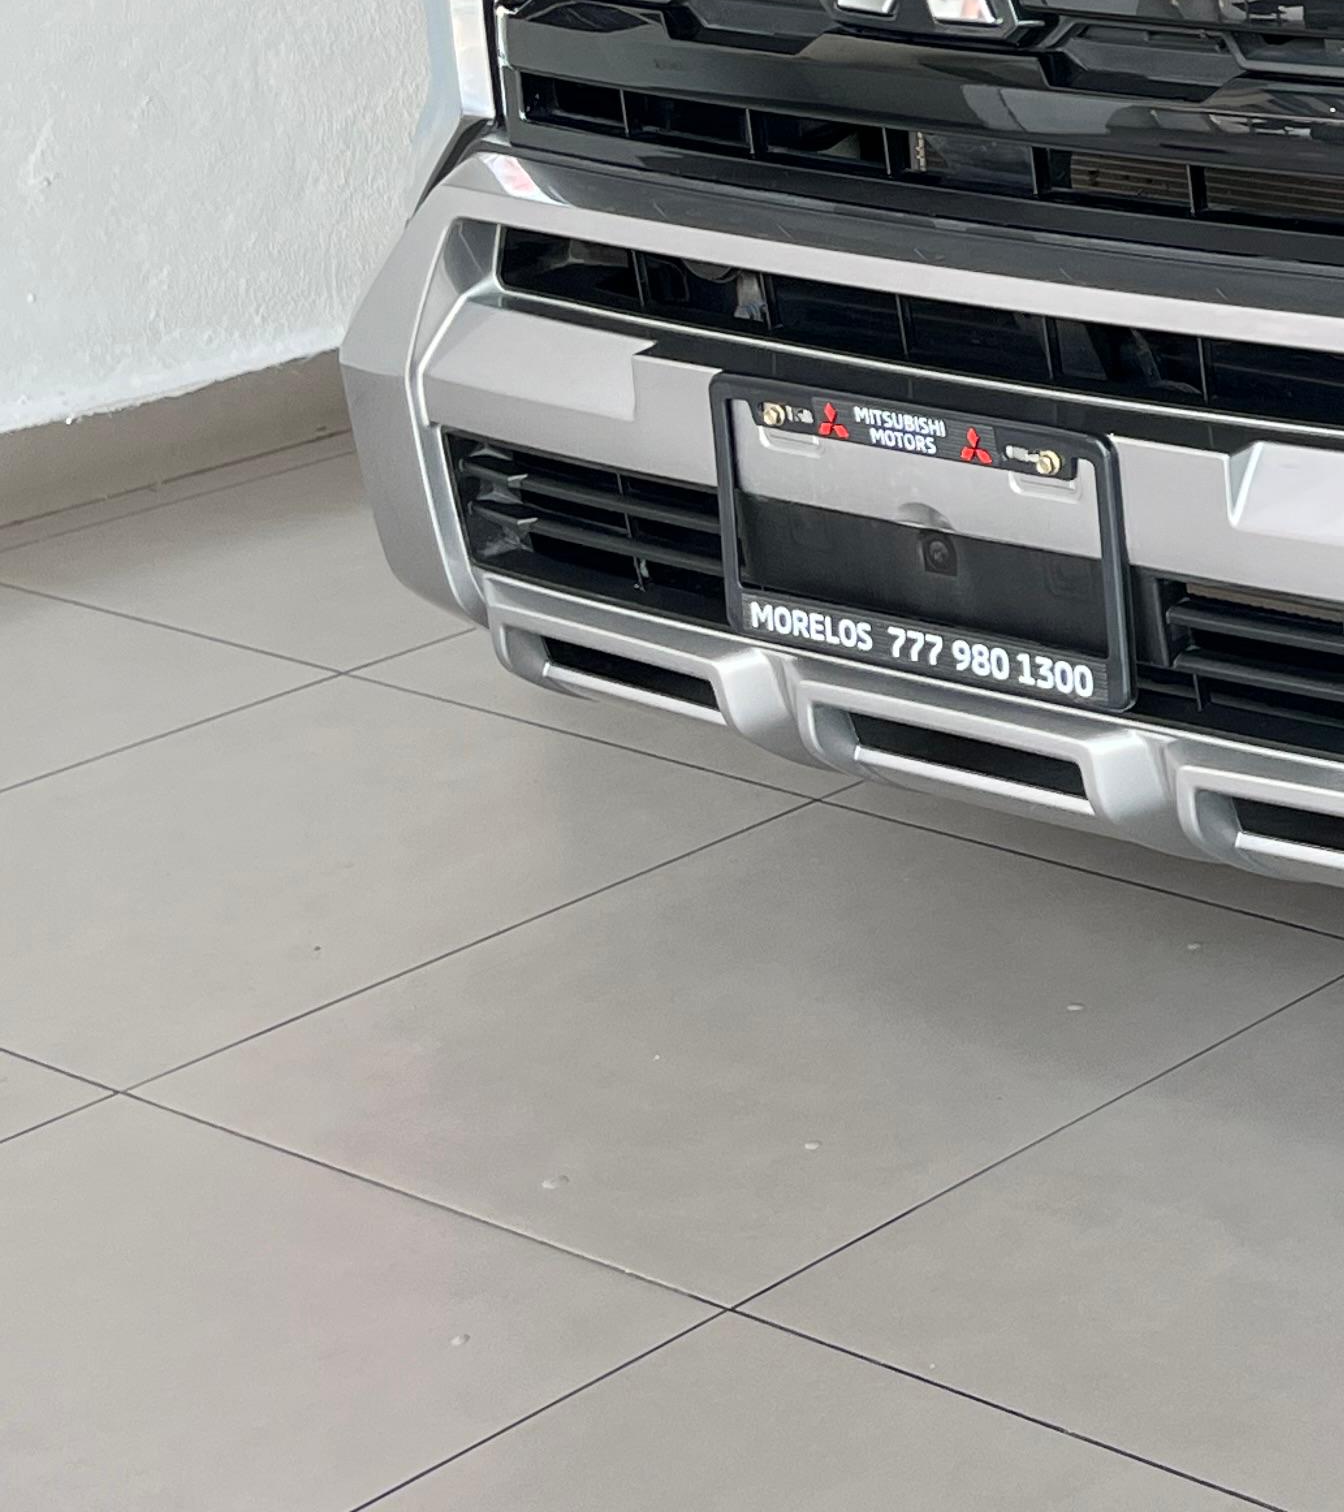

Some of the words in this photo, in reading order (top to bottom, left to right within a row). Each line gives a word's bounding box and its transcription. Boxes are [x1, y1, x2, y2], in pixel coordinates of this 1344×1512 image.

[853, 405, 947, 439] MITSUBISHI
[869, 427, 938, 456] MOTORS
[750, 601, 873, 652] MORELOS
[887, 626, 943, 666] 777
[952, 639, 1010, 681] 980
[1017, 653, 1094, 698] 1300
